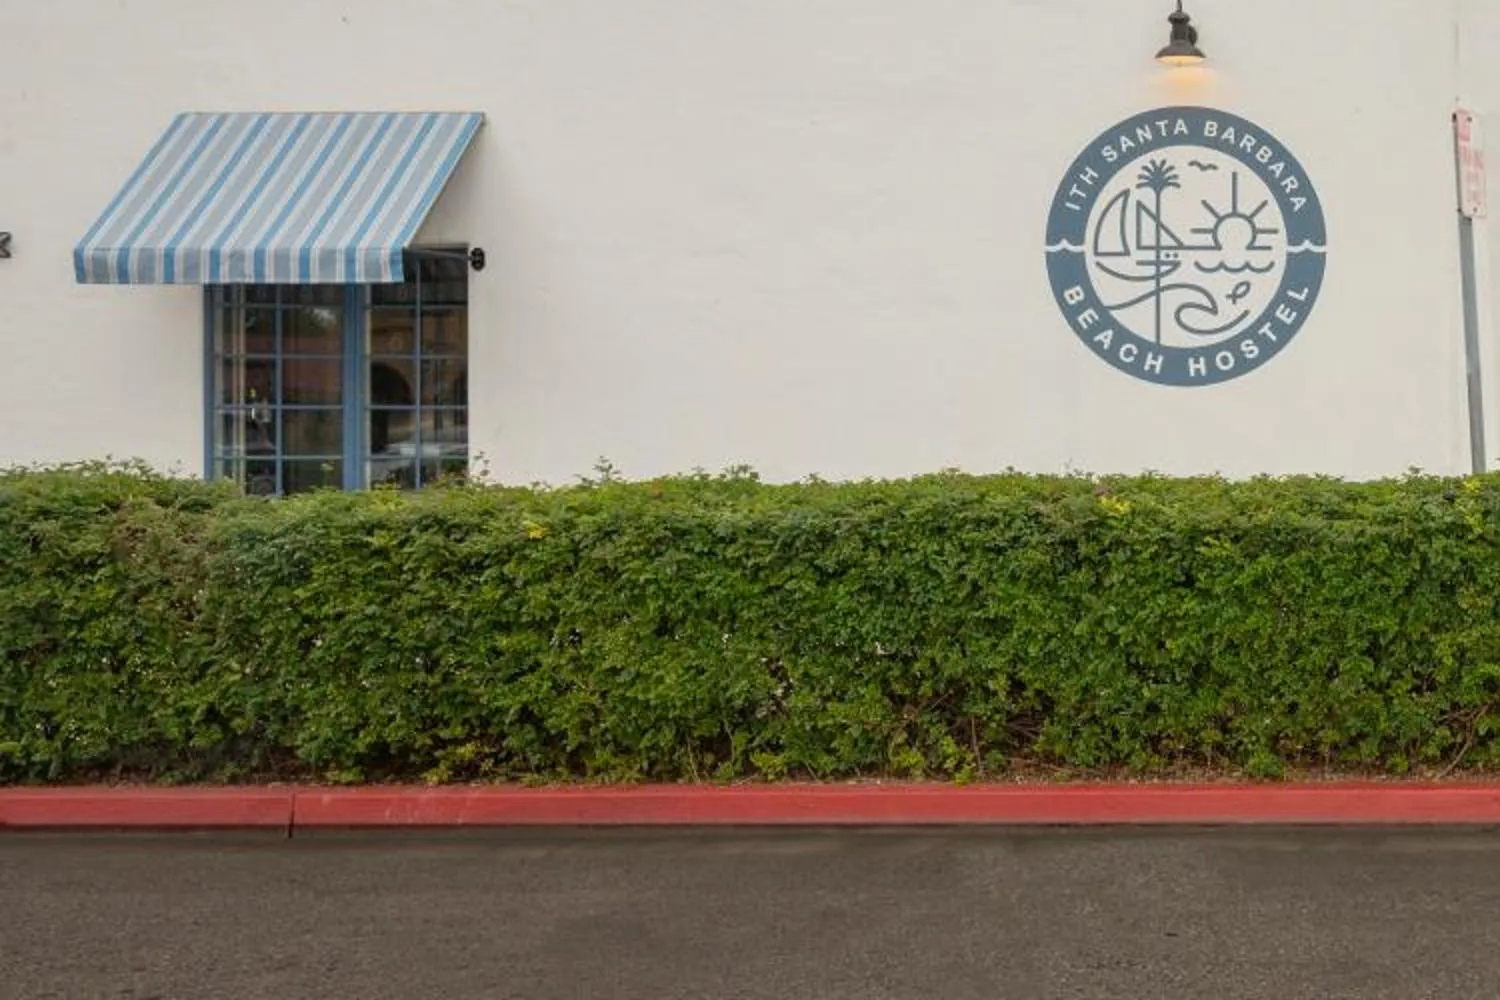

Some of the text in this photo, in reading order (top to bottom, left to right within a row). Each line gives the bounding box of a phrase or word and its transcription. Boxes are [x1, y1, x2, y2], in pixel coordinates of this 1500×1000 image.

[1065, 119, 1308, 213] ITH SANTA BARBARA
[1063, 284, 1310, 377] BEACH HOSTEL
